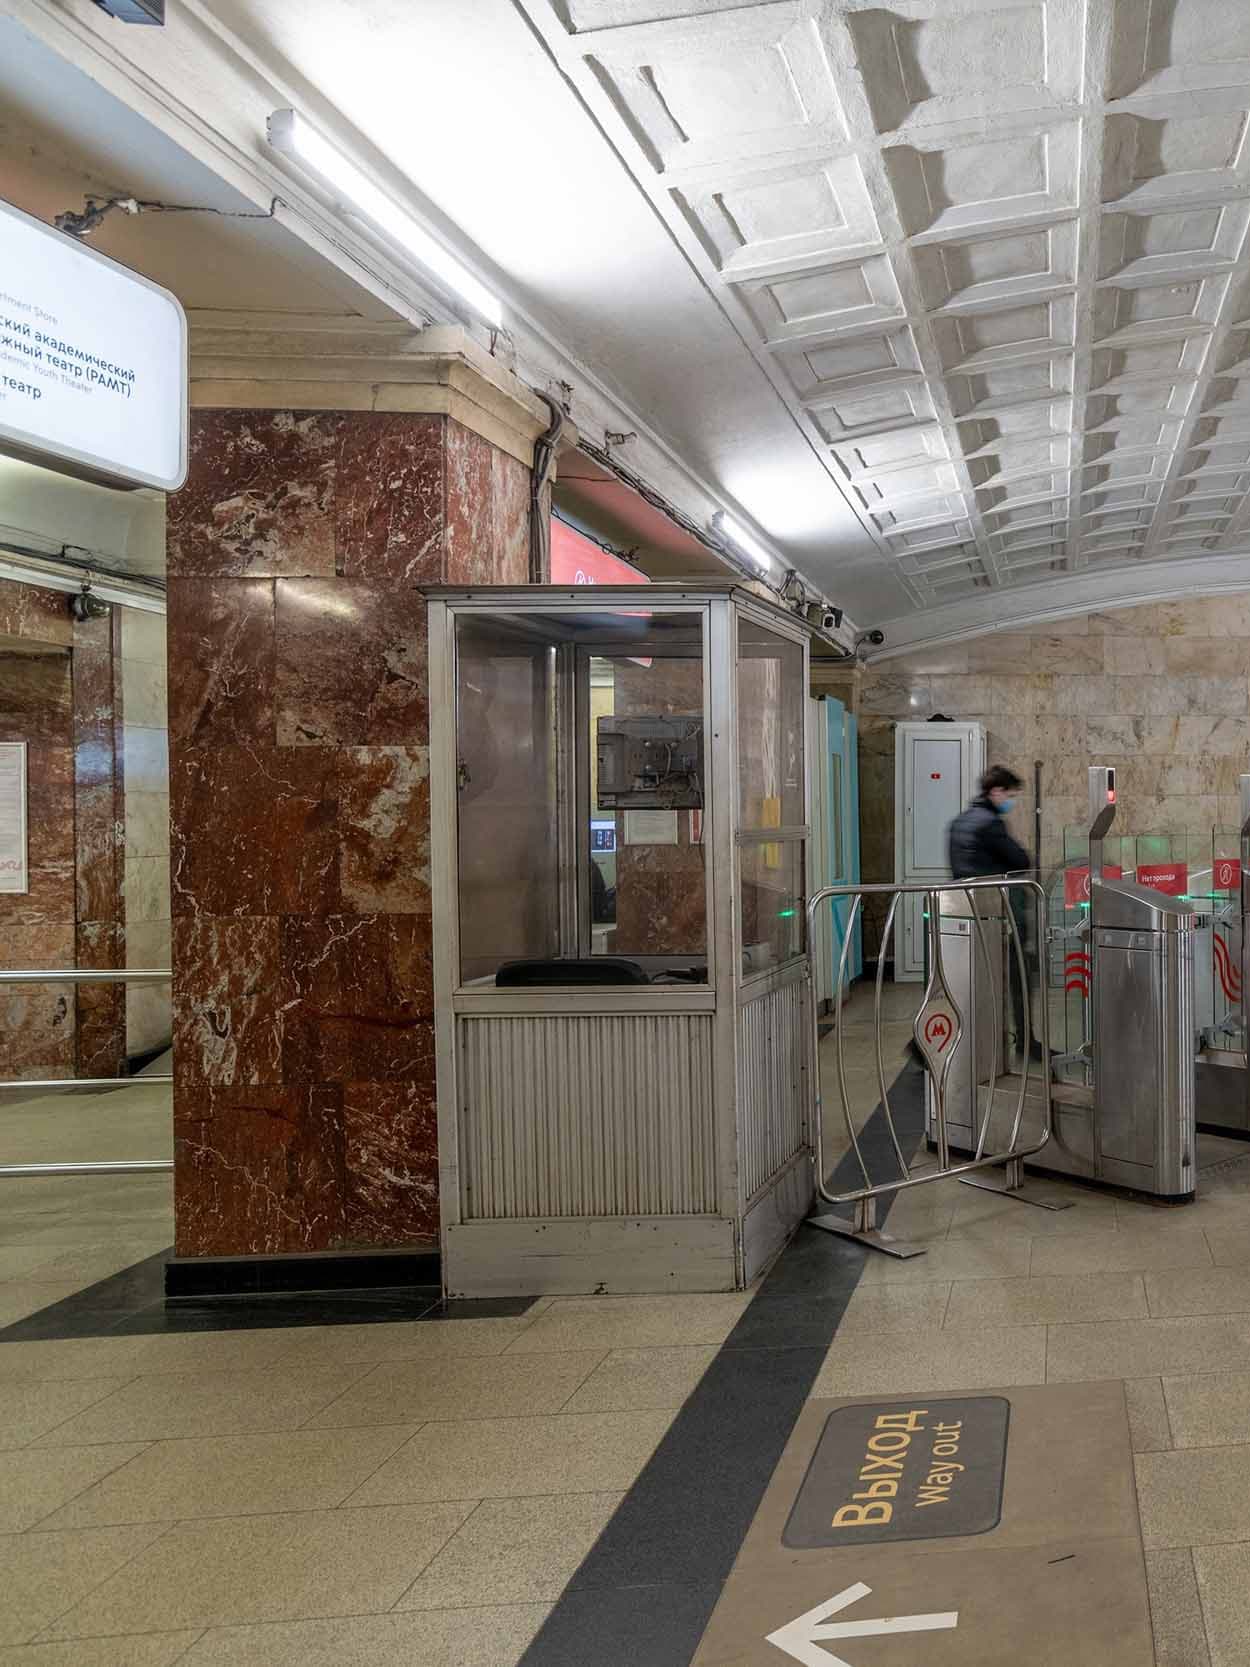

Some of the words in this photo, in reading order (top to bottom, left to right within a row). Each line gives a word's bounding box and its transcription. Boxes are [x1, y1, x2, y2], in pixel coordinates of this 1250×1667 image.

[34, 331, 136, 382] академический
[46, 352, 83, 378] театр
[86, 365, 131, 399] (РАМТ)
[2, 374, 43, 400] театр
[931, 1420, 963, 1456] out
[914, 1460, 966, 1508] Way
